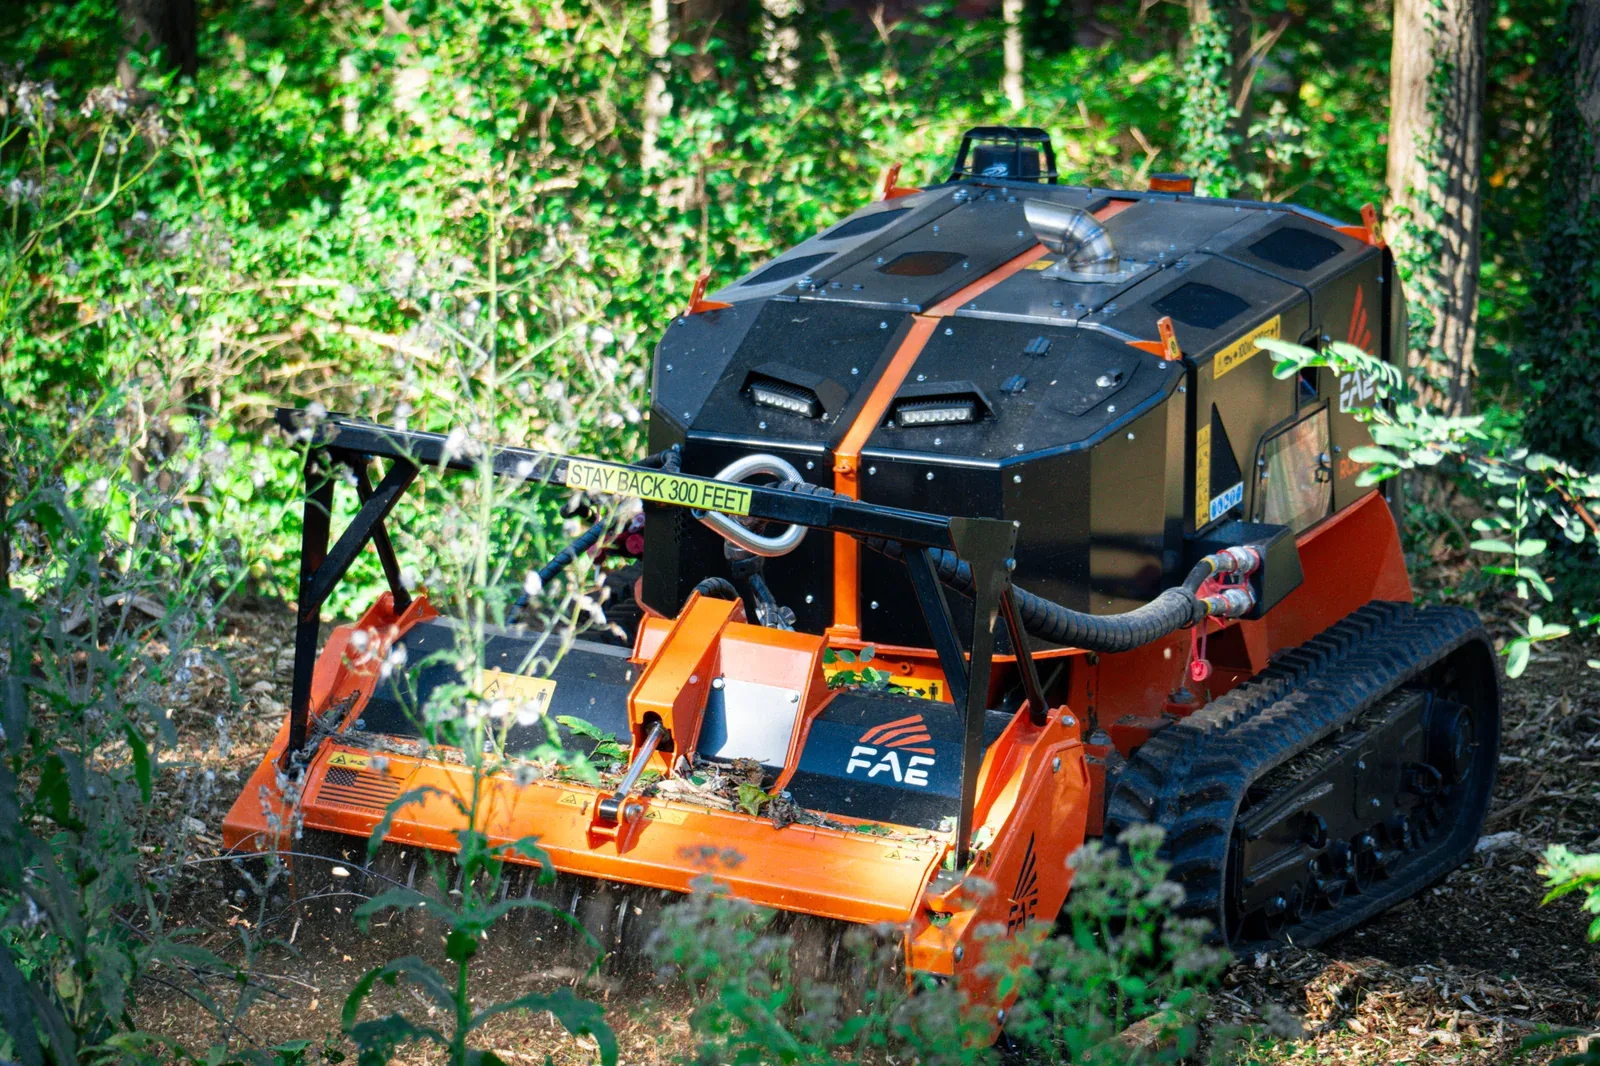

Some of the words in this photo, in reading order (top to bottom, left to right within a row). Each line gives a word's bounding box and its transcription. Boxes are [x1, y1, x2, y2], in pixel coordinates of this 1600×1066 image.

[1339, 369, 1374, 413] FAE
[570, 464, 615, 490] STAY
[616, 471, 667, 499] BACK
[668, 479, 699, 504] 300
[701, 485, 749, 512] FEET
[846, 745, 936, 787] FAE
[315, 799, 355, 810] DISTRIBUTED
[1006, 898, 1038, 937] FAE
